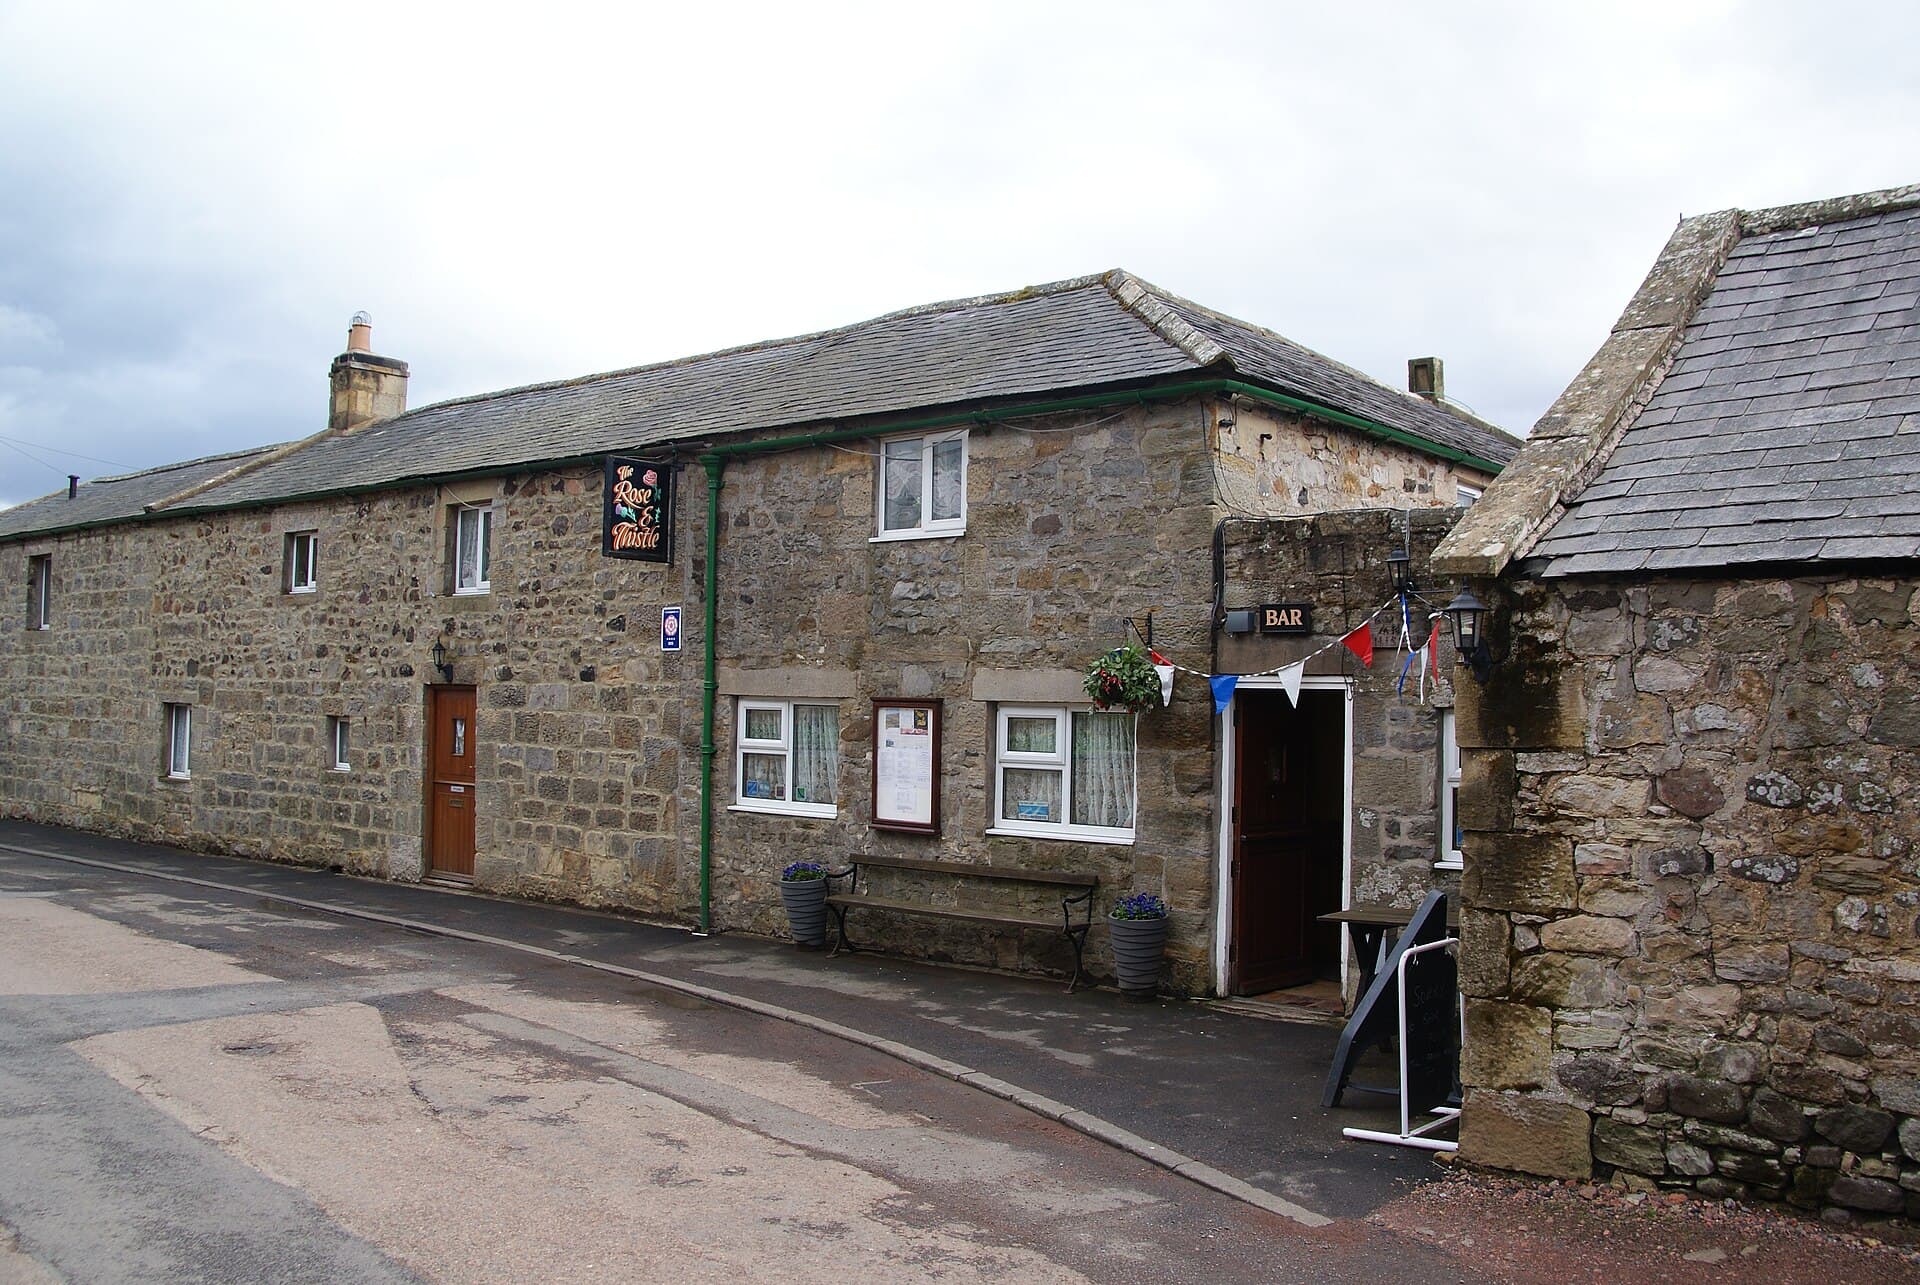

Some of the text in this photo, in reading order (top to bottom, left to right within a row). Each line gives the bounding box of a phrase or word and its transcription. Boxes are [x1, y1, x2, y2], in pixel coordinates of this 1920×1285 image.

[617, 465, 635, 480] The
[613, 480, 652, 509] Rose
[639, 506, 654, 528] &
[611, 521, 660, 551] Thistle
[1265, 609, 1304, 626] BAR
